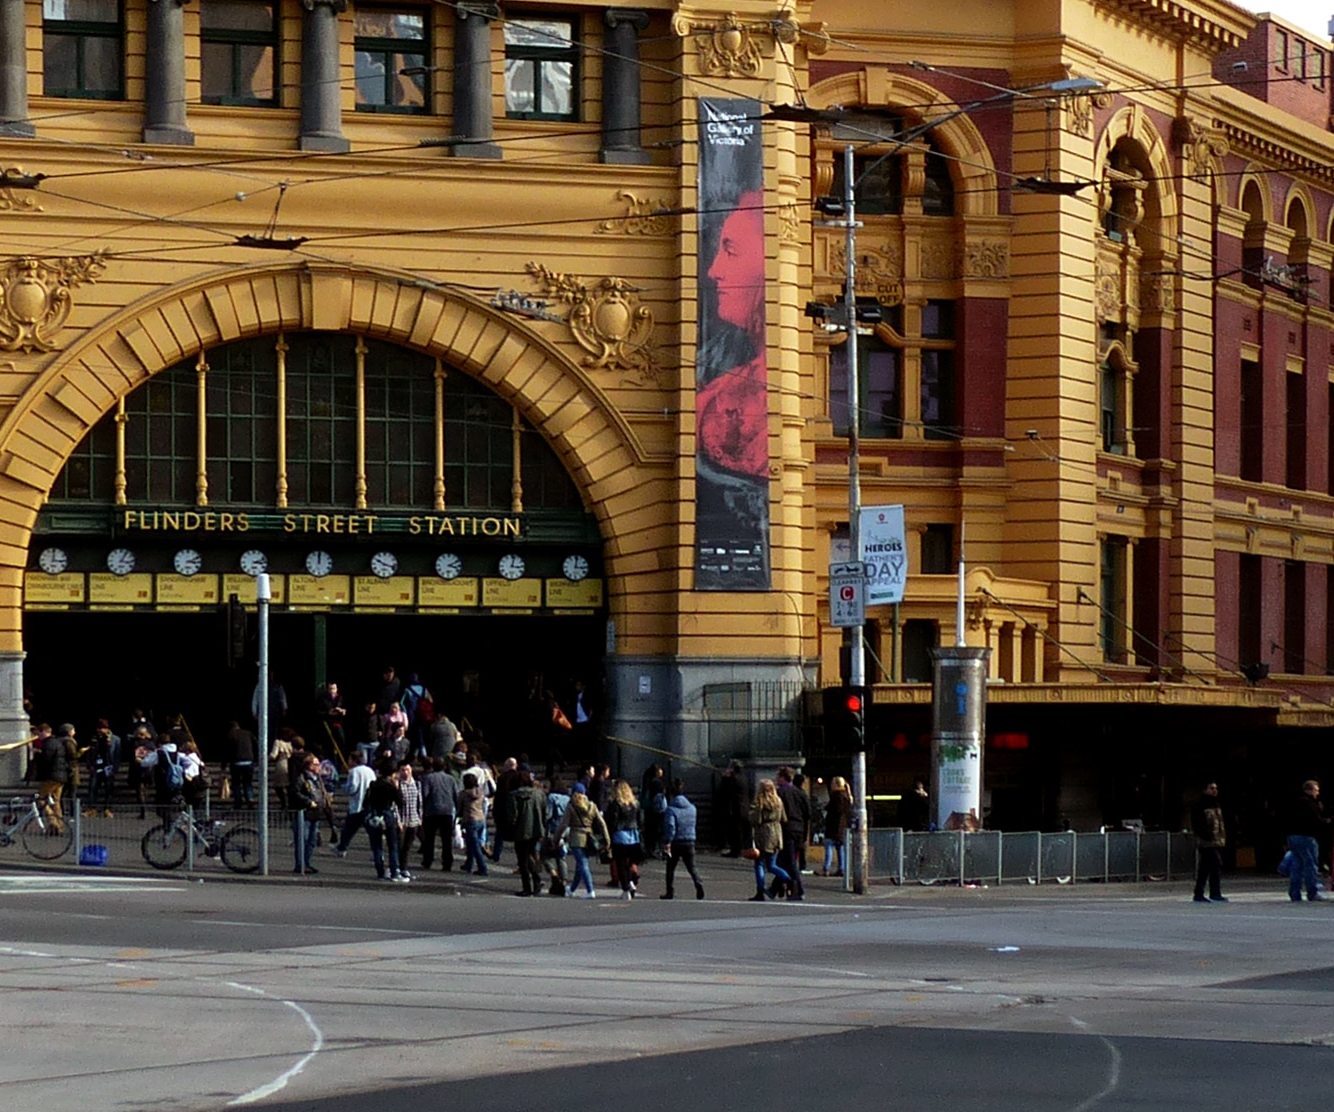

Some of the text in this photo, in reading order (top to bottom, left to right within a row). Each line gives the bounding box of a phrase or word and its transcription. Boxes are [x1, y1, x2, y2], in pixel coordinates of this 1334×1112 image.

[707, 122, 754, 135] Gllry of
[708, 134, 745, 146] Victoria
[878, 284, 898, 293] CUT
[879, 295, 899, 304] OFF
[124, 510, 522, 536] FLINDERS STREET STATION
[865, 543, 903, 553] HEROES
[864, 554, 905, 563] FATHER'S
[864, 562, 904, 578] DAY
[865, 577, 903, 586] APPEAL
